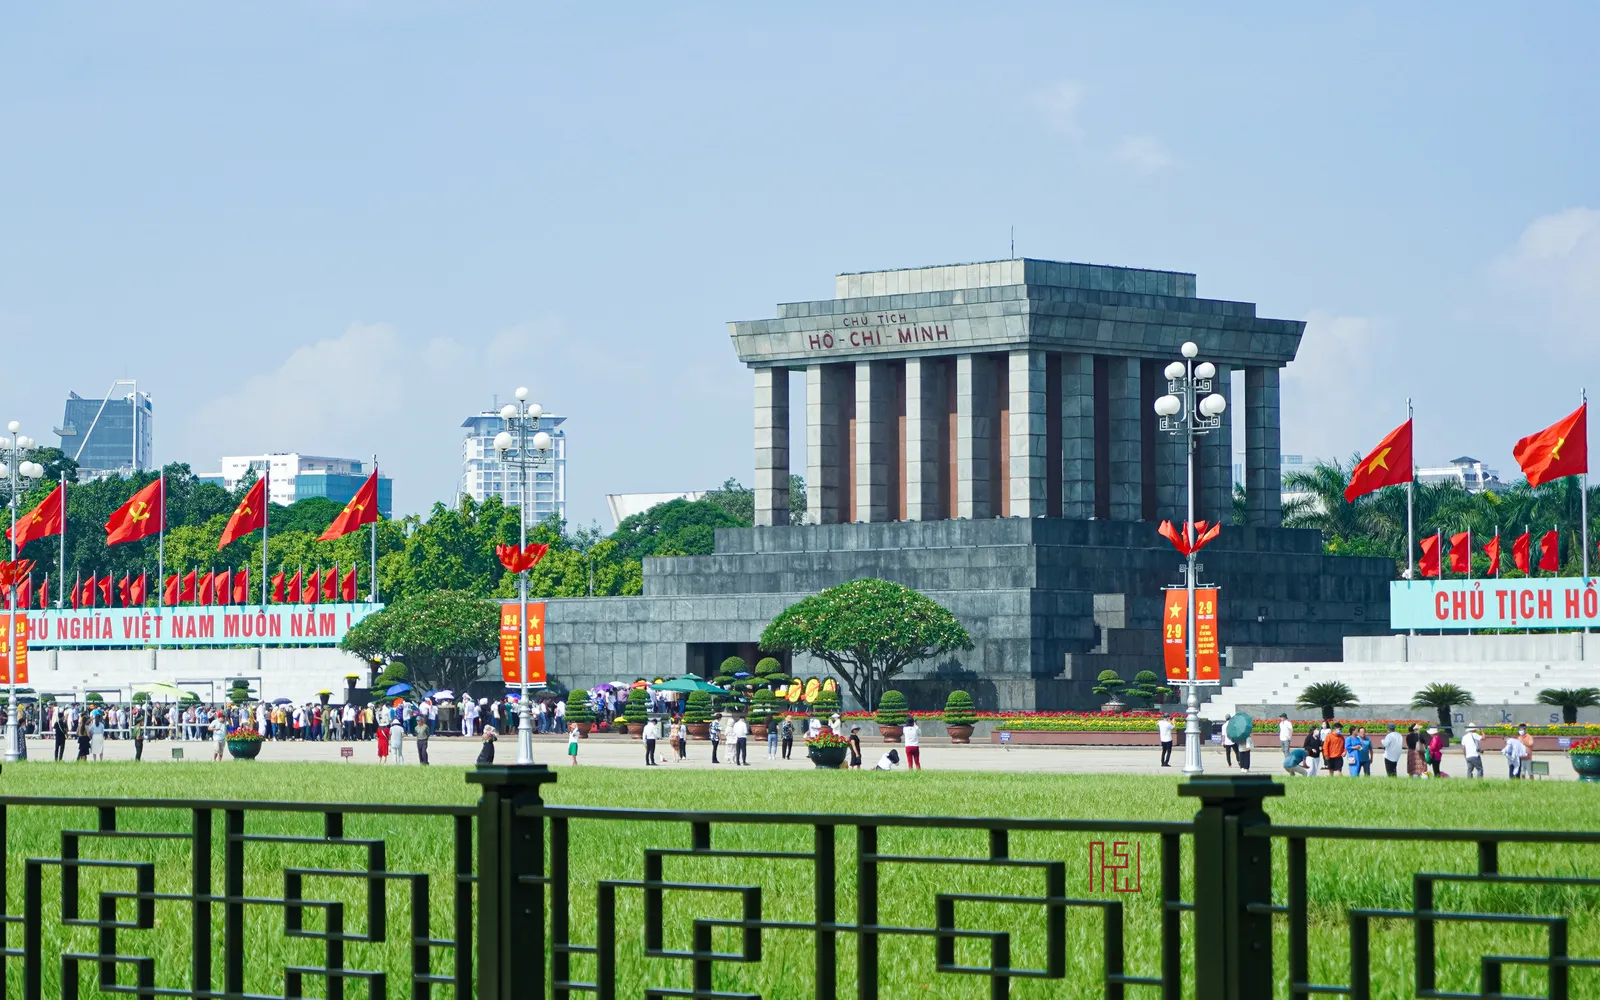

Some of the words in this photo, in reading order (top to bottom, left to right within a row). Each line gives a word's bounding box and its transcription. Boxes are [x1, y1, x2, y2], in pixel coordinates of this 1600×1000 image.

[1435, 581, 1485, 621] CHỦ
[1496, 588, 1553, 625] TỊCH
[1565, 578, 1599, 619] HỒ
[26, 611, 49, 640] HỦ
[57, 612, 114, 640] NGHĨA
[122, 611, 163, 643] VIỆT
[172, 614, 215, 638] NAM
[224, 609, 282, 638] MUÔN
[291, 608, 336, 637] NĂM
